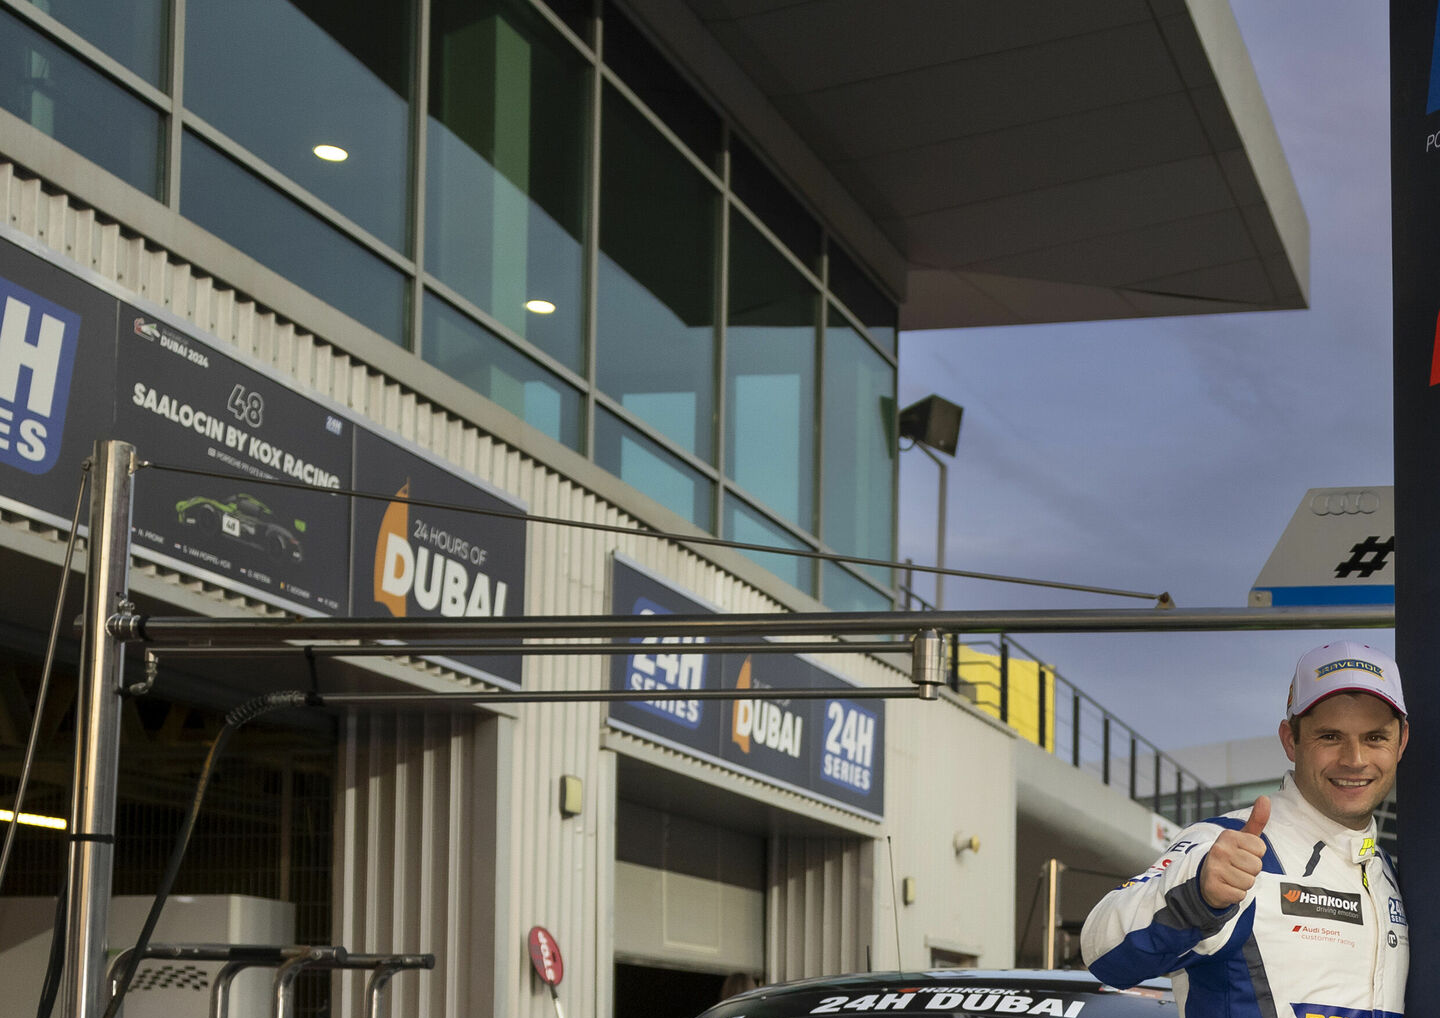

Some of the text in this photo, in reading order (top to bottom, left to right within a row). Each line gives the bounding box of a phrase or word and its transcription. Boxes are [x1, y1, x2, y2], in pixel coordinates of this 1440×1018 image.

[160, 335, 188, 358] DUBAI
[227, 383, 264, 428] 48
[132, 382, 341, 496] SAALOCIN BY KOX RACING
[413, 519, 489, 566] 24 HOURS OF
[382, 532, 508, 618] DUBAI
[736, 697, 803, 758] DUBAI
[825, 701, 875, 767] 24H
[823, 754, 872, 791] SERIES
[1301, 934, 1337, 943] customer
[1302, 926, 1341, 937] Audi Sport
[810, 993, 1086, 1018] 24H DUBAI
